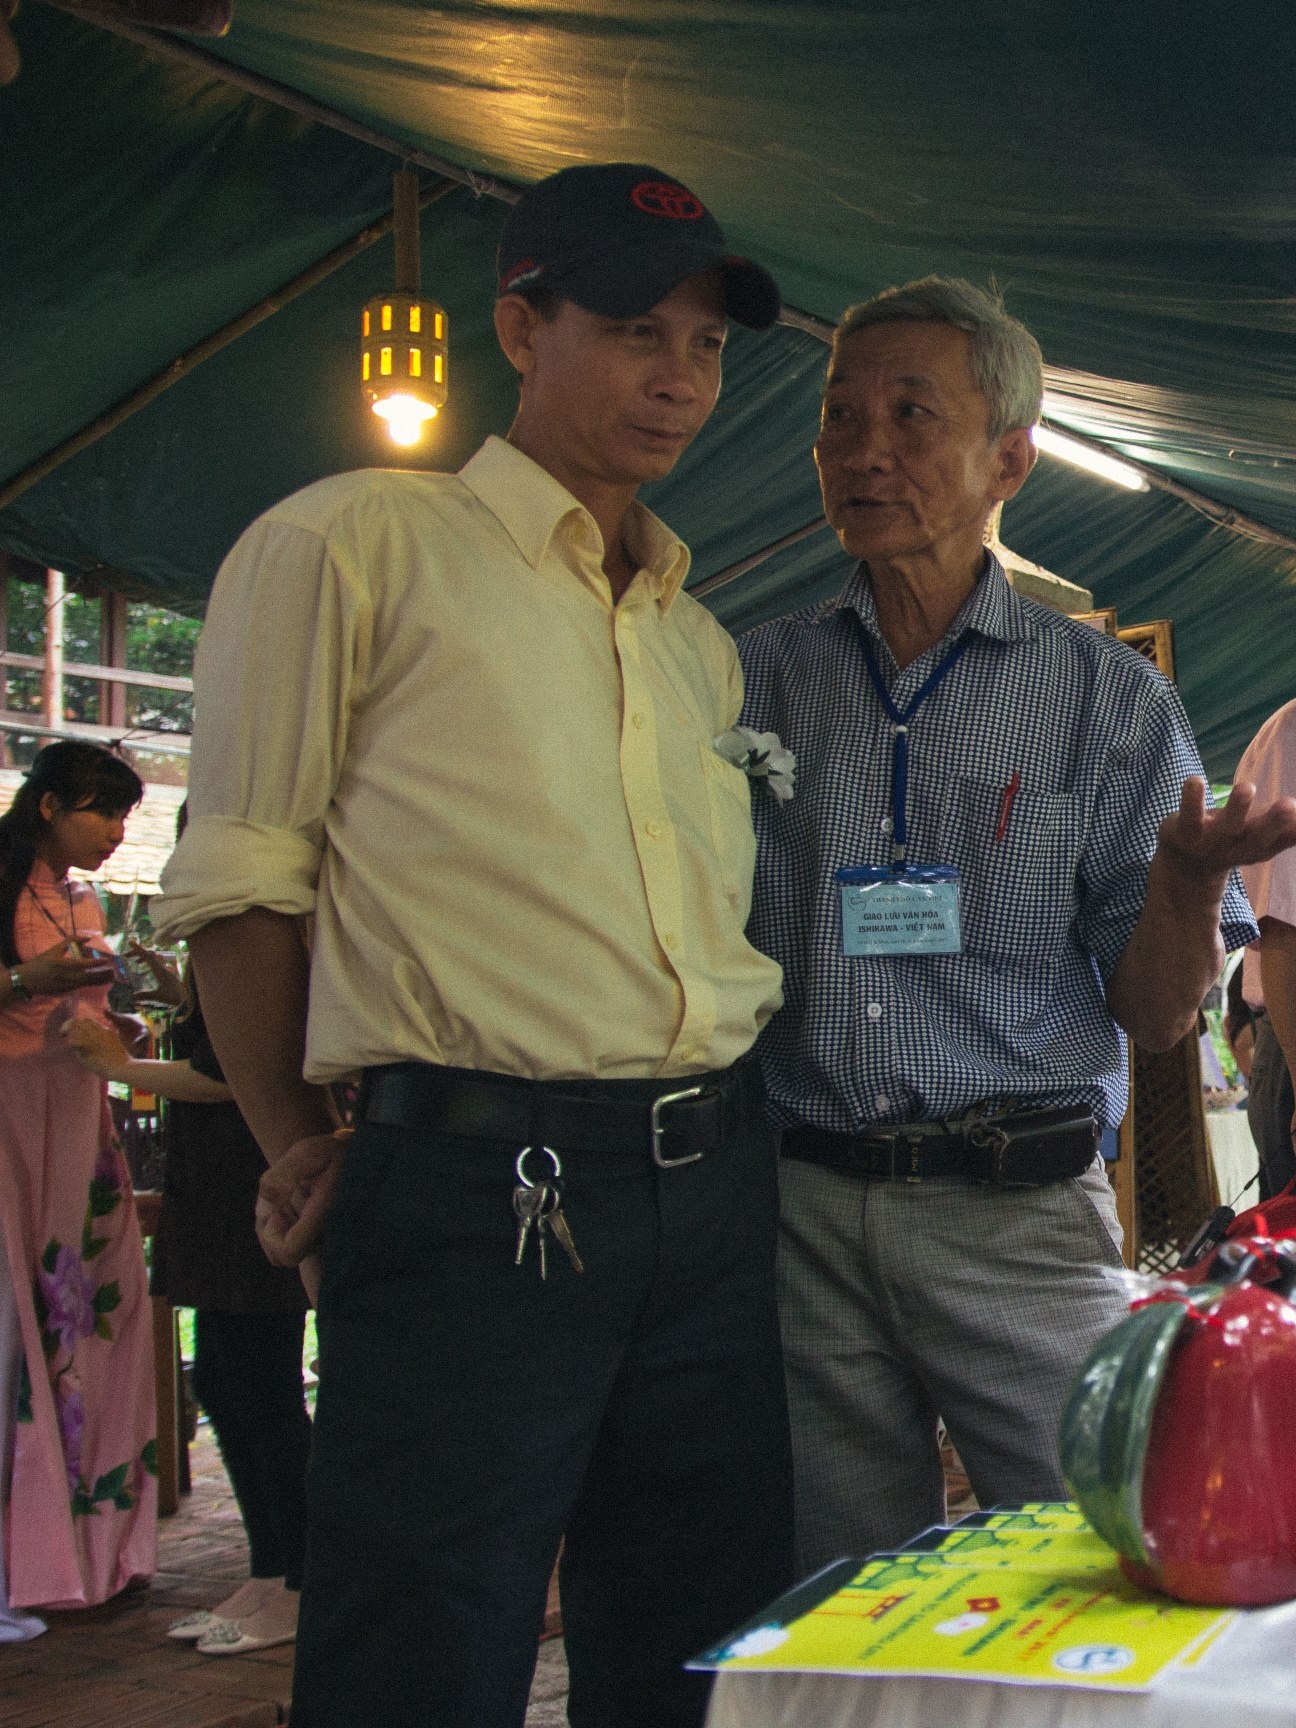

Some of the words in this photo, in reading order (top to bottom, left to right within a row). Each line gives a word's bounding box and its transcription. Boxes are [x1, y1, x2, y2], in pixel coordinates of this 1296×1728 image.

[863, 912, 882, 920] GIAO
[858, 923, 898, 933] ISHIKAWA
[905, 921, 924, 932] VIỆT
[927, 922, 945, 931] NAM
